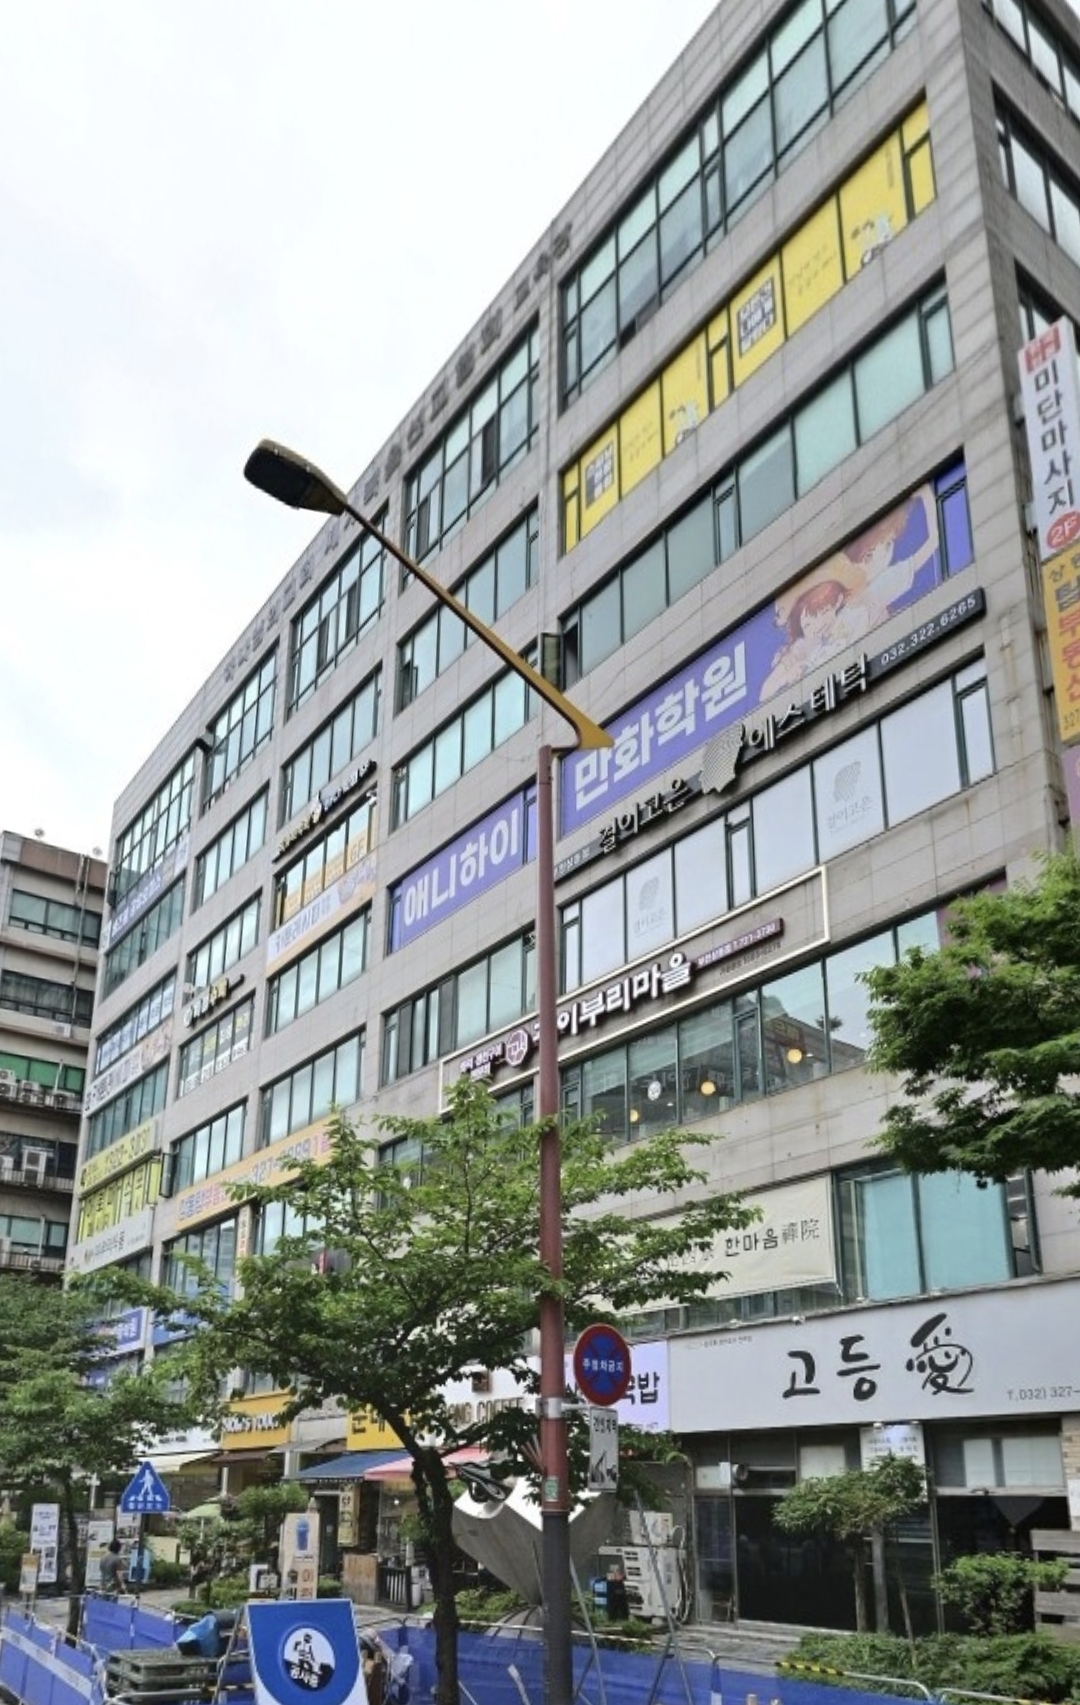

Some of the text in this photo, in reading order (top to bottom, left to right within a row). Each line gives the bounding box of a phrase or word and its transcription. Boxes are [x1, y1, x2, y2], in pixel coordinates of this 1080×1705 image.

[574, 640, 747, 812] 만화학원
[749, 652, 868, 751] 에스테틱
[403, 808, 520, 927] 애니하이
